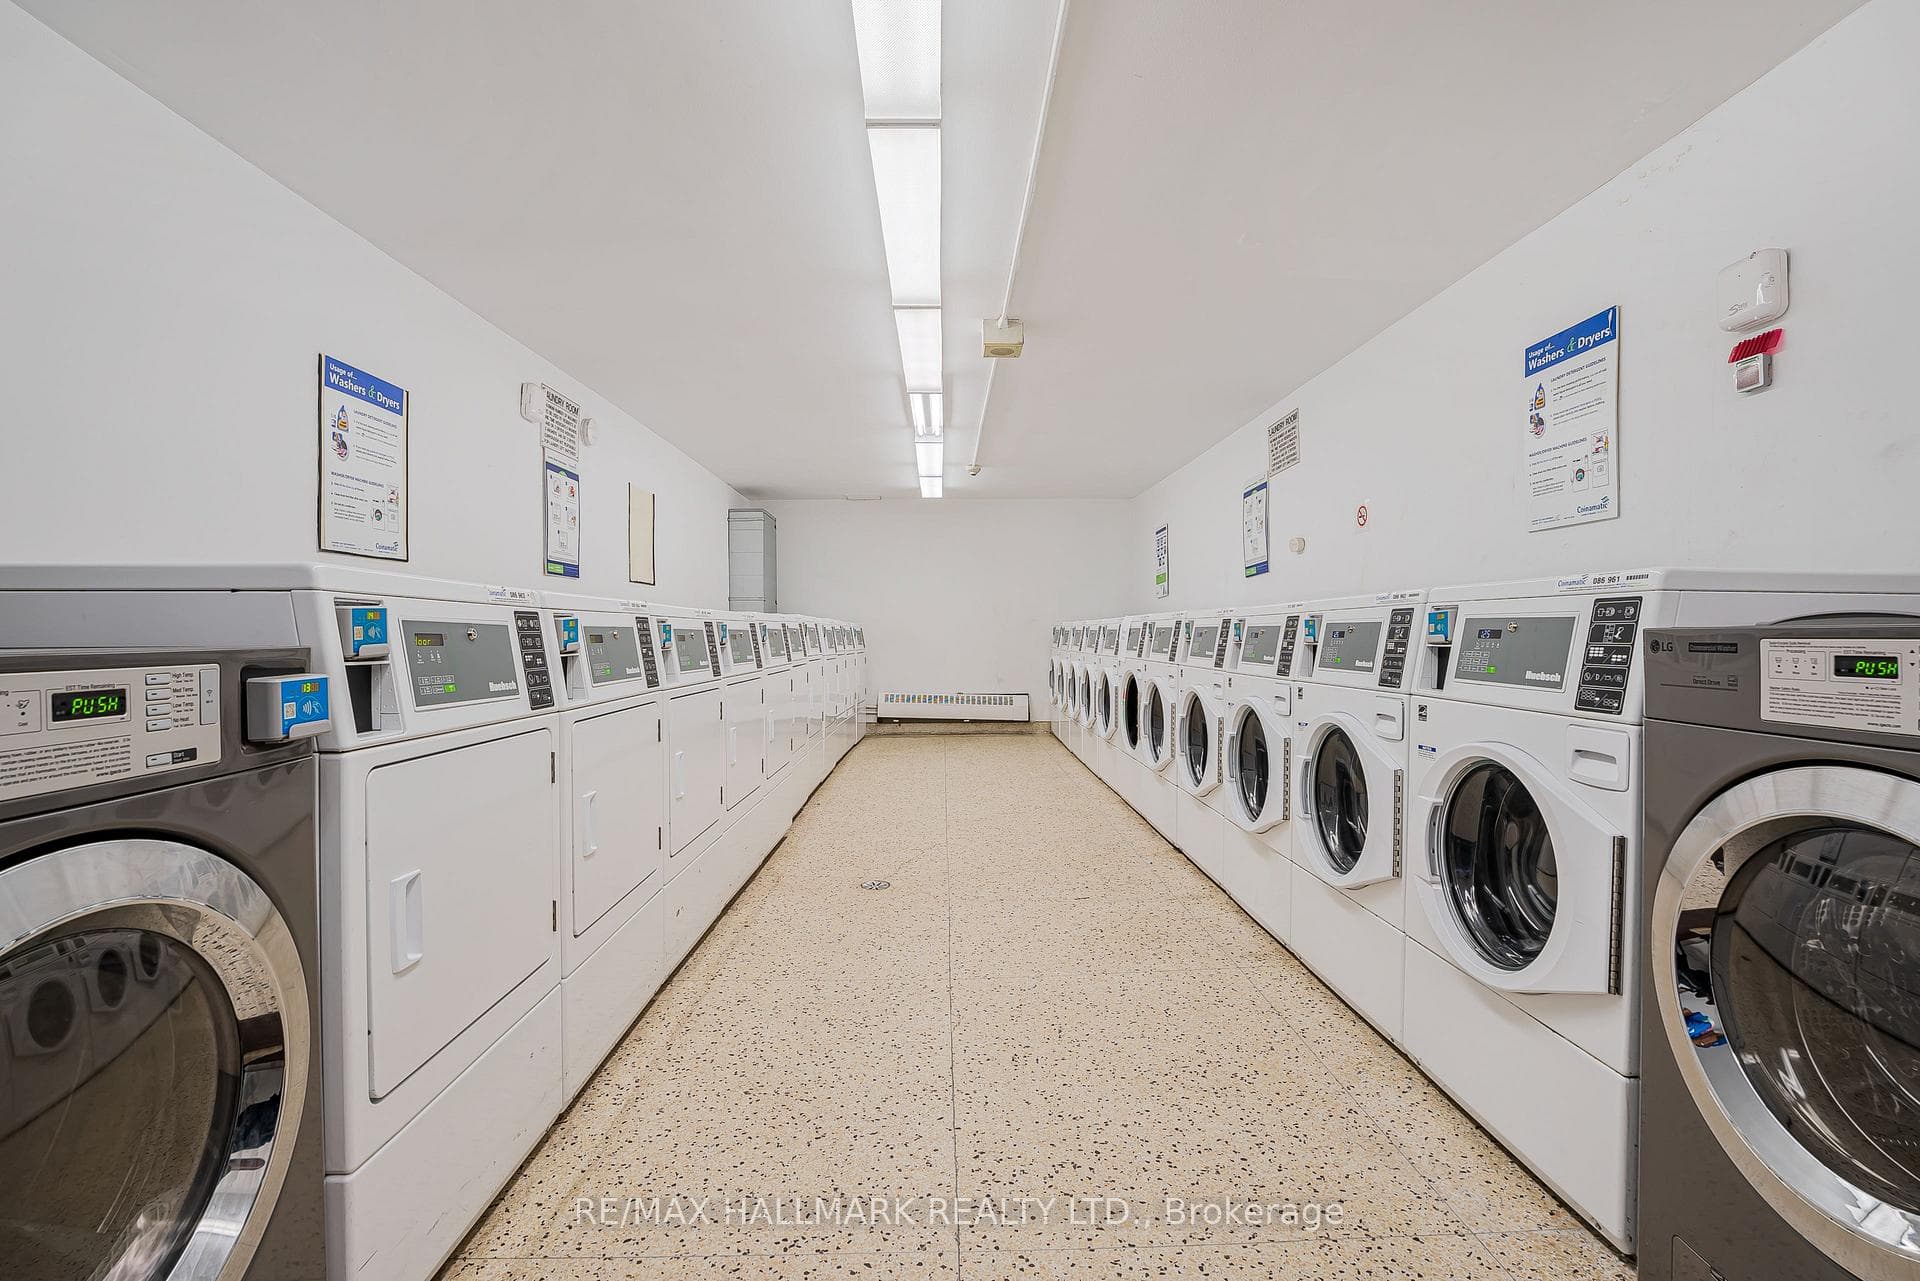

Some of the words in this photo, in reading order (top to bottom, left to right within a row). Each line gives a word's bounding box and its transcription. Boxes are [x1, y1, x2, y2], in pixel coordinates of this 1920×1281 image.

[1528, 348, 1544, 358] Usage
[1528, 347, 1565, 371] Washers
[1567, 336, 1577, 353] &
[329, 363, 346, 377] Usage
[329, 371, 366, 396] Washers
[368, 384, 376, 400] &
[376, 391, 401, 410] Dryers
[1576, 502, 1608, 514] Coinamatic
[1661, 641, 1674, 652] LG
[1855, 661, 1898, 676] PUSH
[1525, 670, 1561, 683] Huebsch
[71, 696, 119, 715] PUSH
